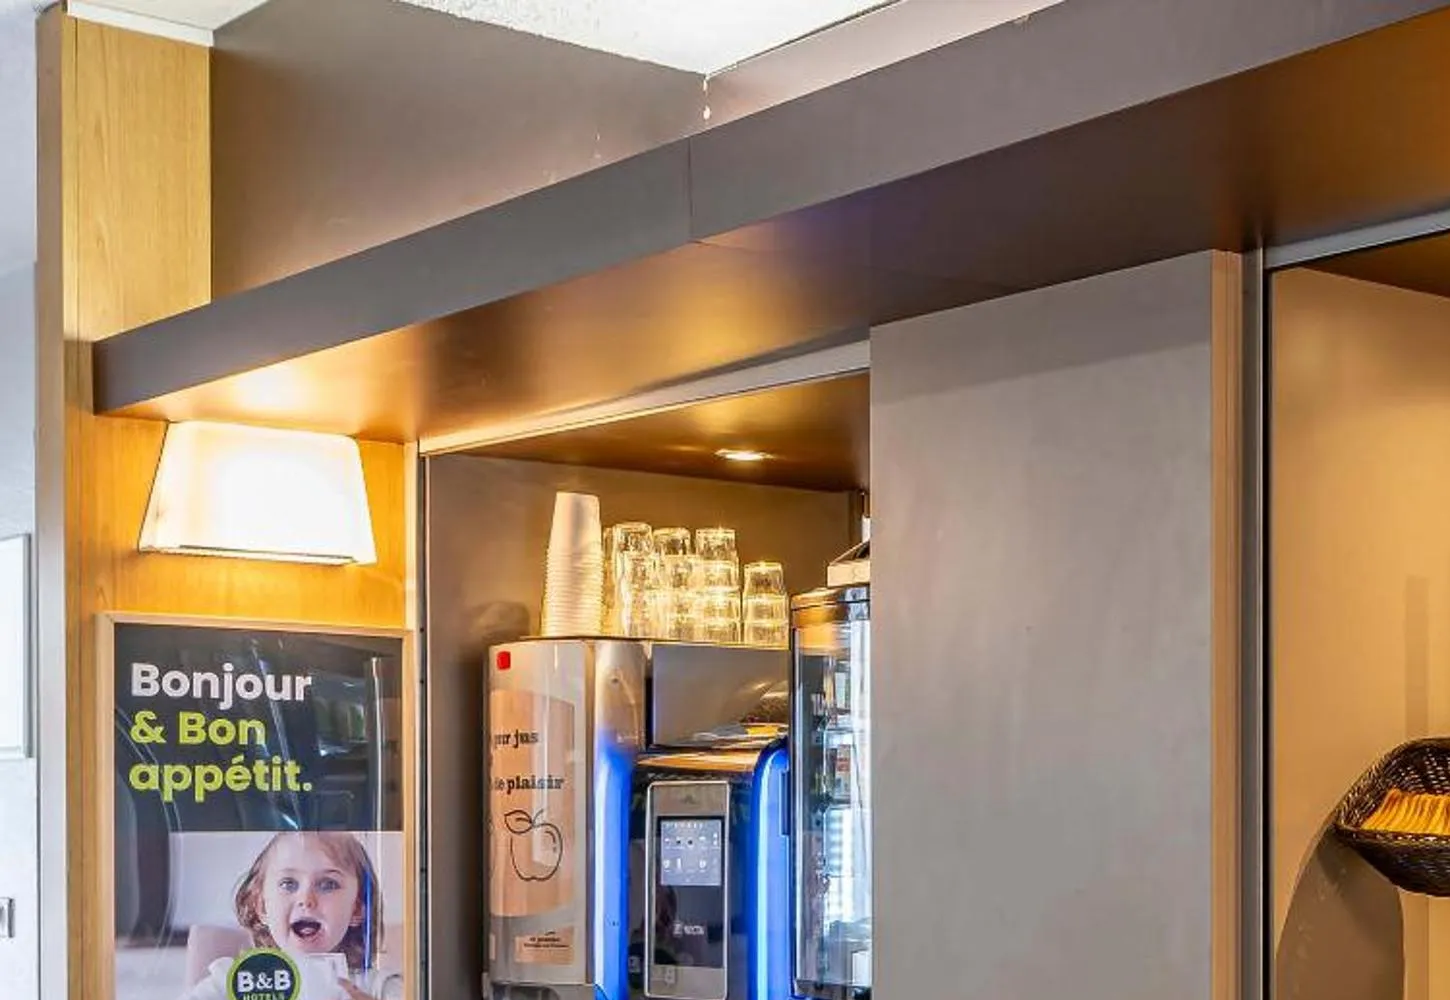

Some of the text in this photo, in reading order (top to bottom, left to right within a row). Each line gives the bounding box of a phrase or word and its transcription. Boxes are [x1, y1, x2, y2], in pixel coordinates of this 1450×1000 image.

[131, 662, 312, 710] Bonjour
[129, 710, 267, 747] & Bon
[512, 728, 539, 749] jus
[129, 755, 313, 803] appétit.
[506, 774, 565, 796] plaisir
[237, 969, 292, 993] B&B
